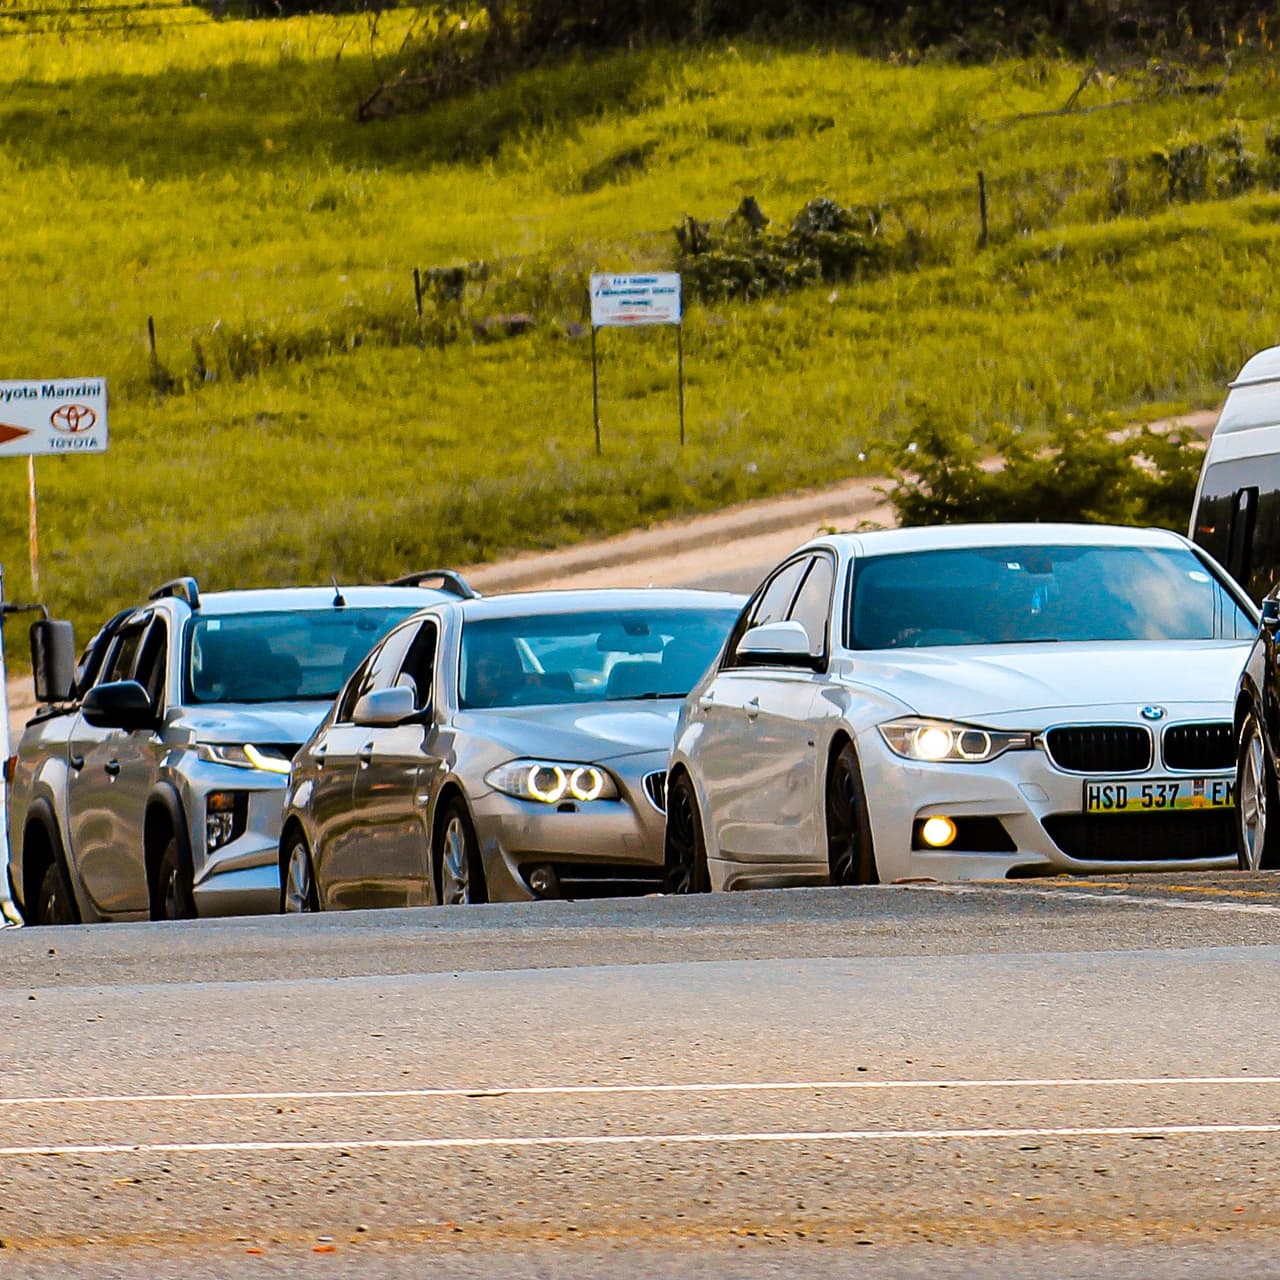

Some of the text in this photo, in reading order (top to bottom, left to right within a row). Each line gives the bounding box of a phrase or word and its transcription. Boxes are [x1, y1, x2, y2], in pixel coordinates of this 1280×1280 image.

[42, 382, 101, 398] Manzini
[49, 438, 98, 449] TOYOTA
[1088, 785, 1128, 810] HSD
[1141, 783, 1180, 808] 537
